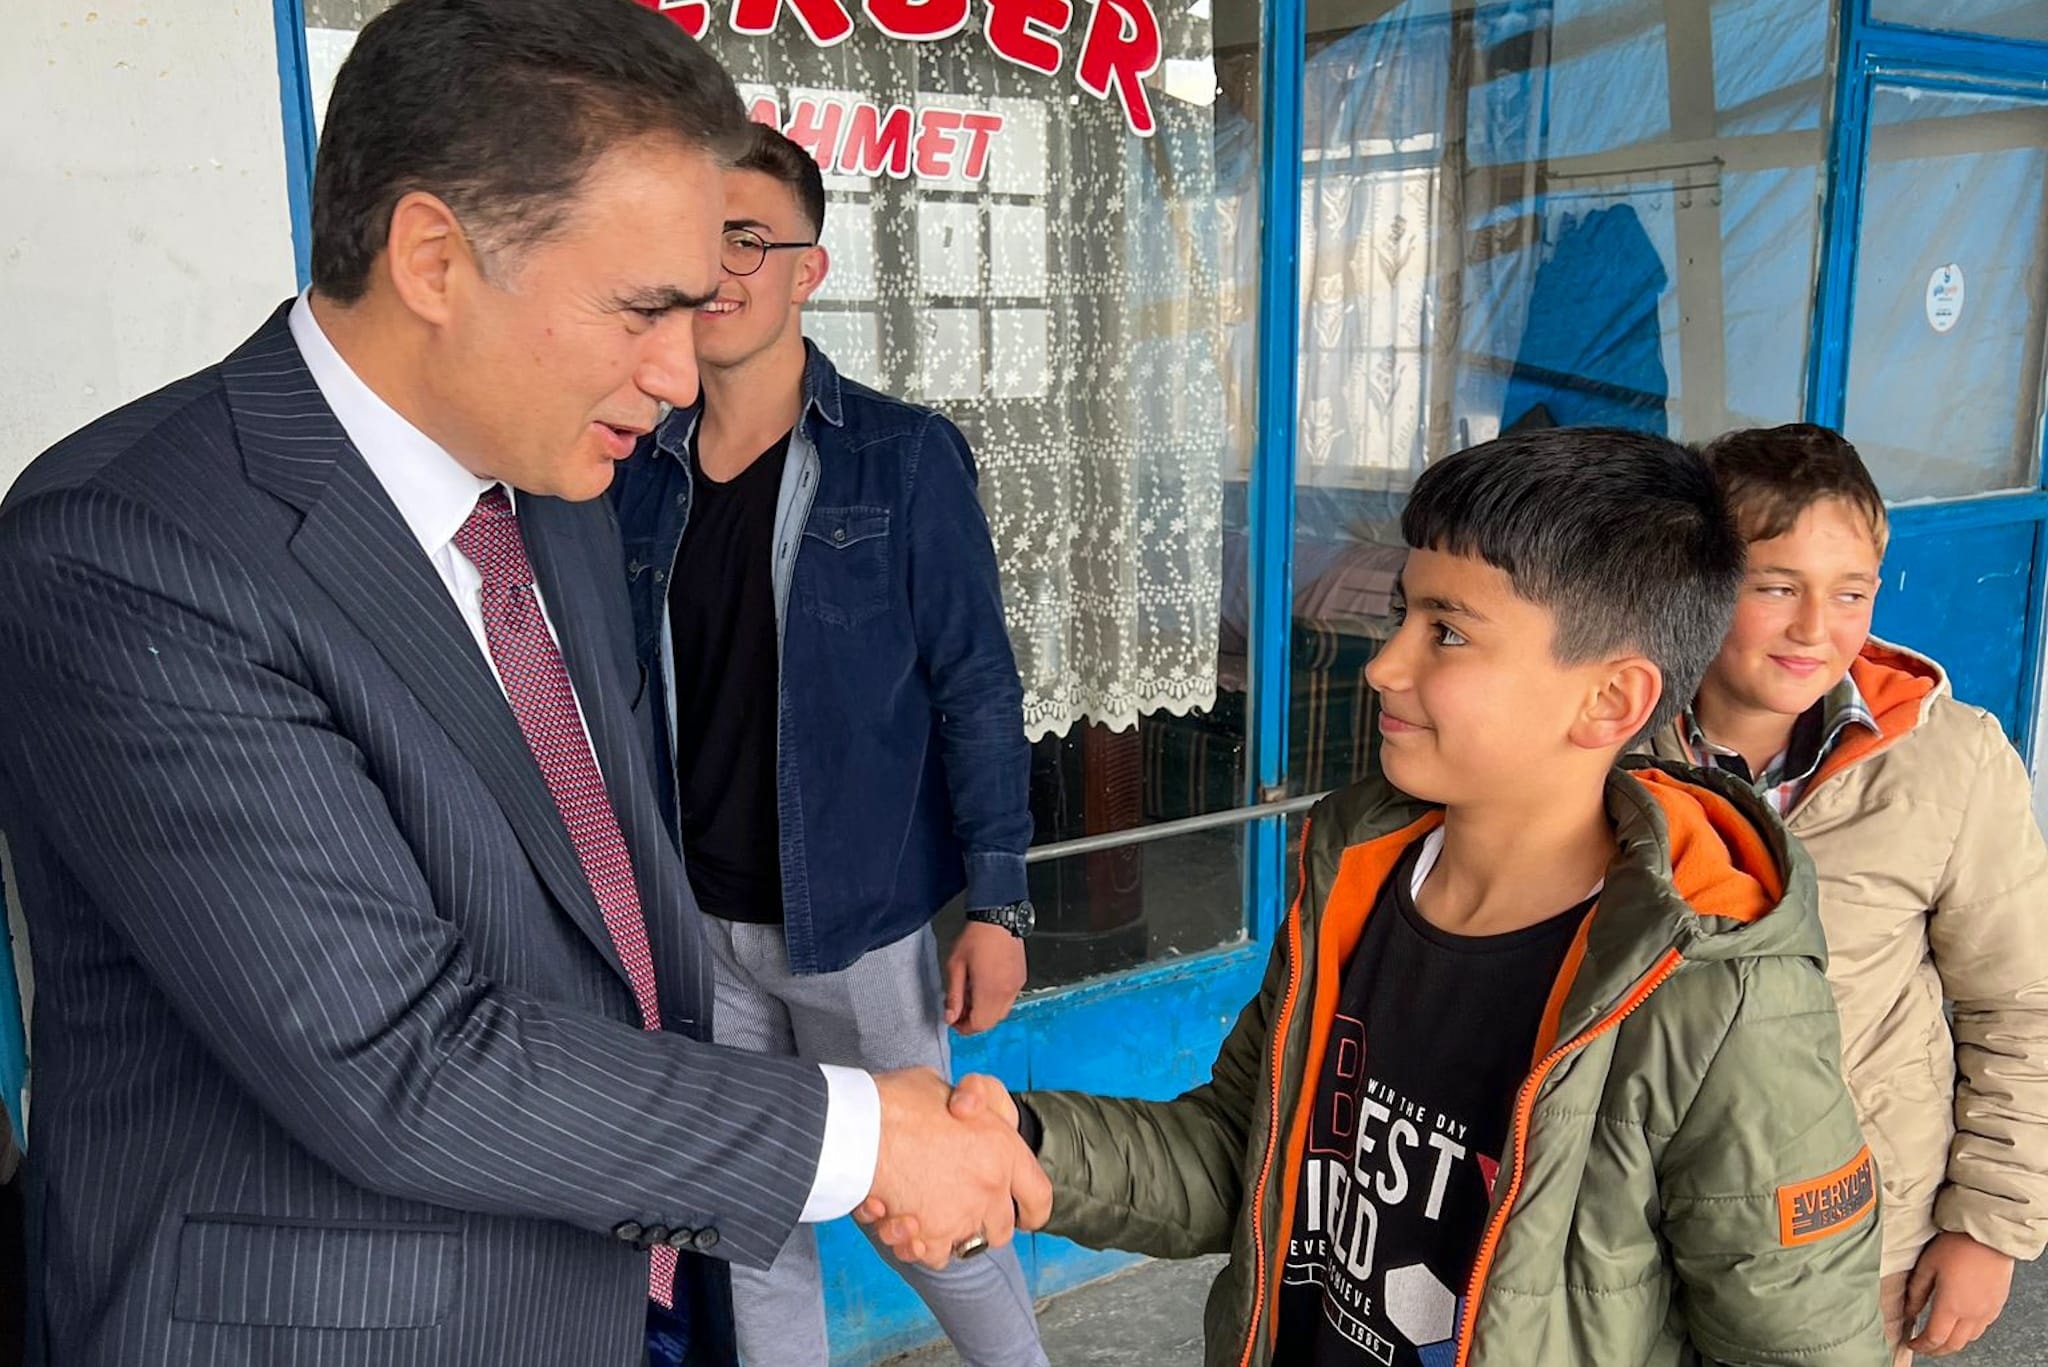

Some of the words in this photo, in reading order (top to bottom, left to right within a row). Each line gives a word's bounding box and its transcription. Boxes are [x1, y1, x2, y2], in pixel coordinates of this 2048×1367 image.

[1367, 1078, 1395, 1105] WIN
[1399, 1096, 1426, 1122] THE
[1436, 1113, 1467, 1140] DAY
[1351, 1323, 1380, 1352] 1986
